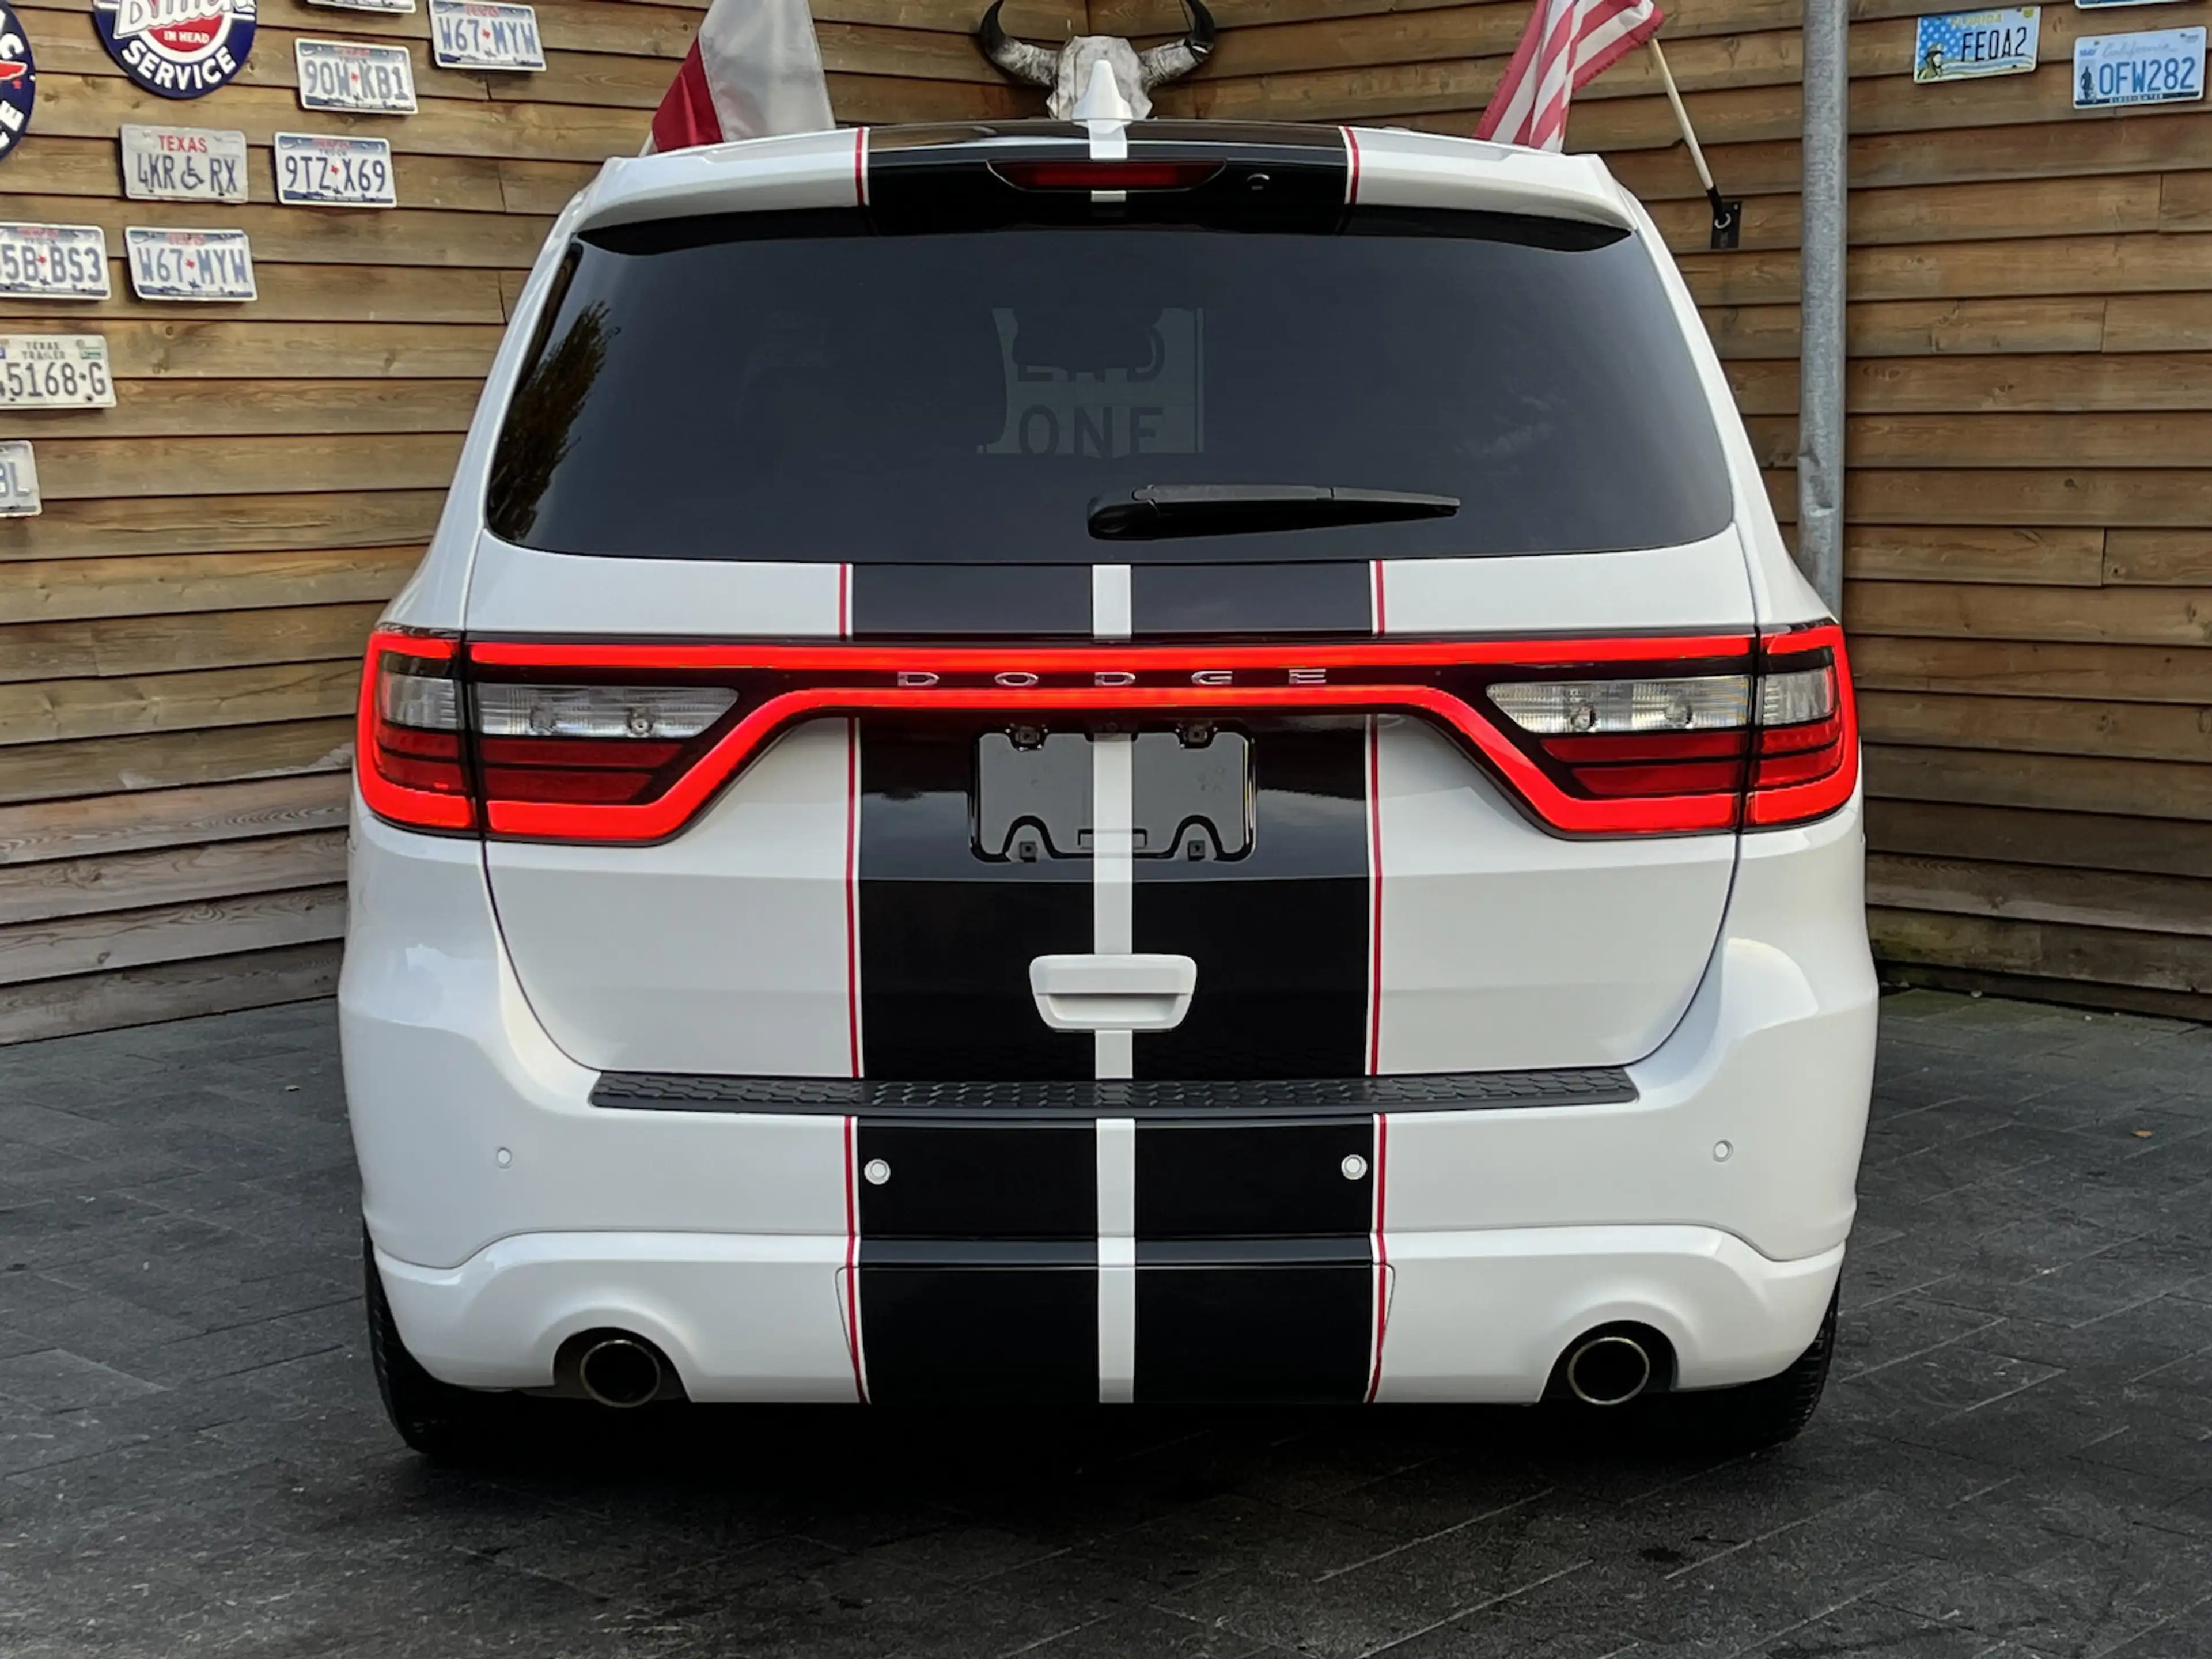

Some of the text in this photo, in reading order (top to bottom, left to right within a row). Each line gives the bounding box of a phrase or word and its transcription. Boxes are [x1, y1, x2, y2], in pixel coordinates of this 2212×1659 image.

[164, 31, 210, 43] IN HEAD
[122, 40, 237, 90] SERVICE
[158, 134, 207, 153] TEXAS
[210, 158, 237, 192] RX
[897, 669, 1327, 687] DODGE
